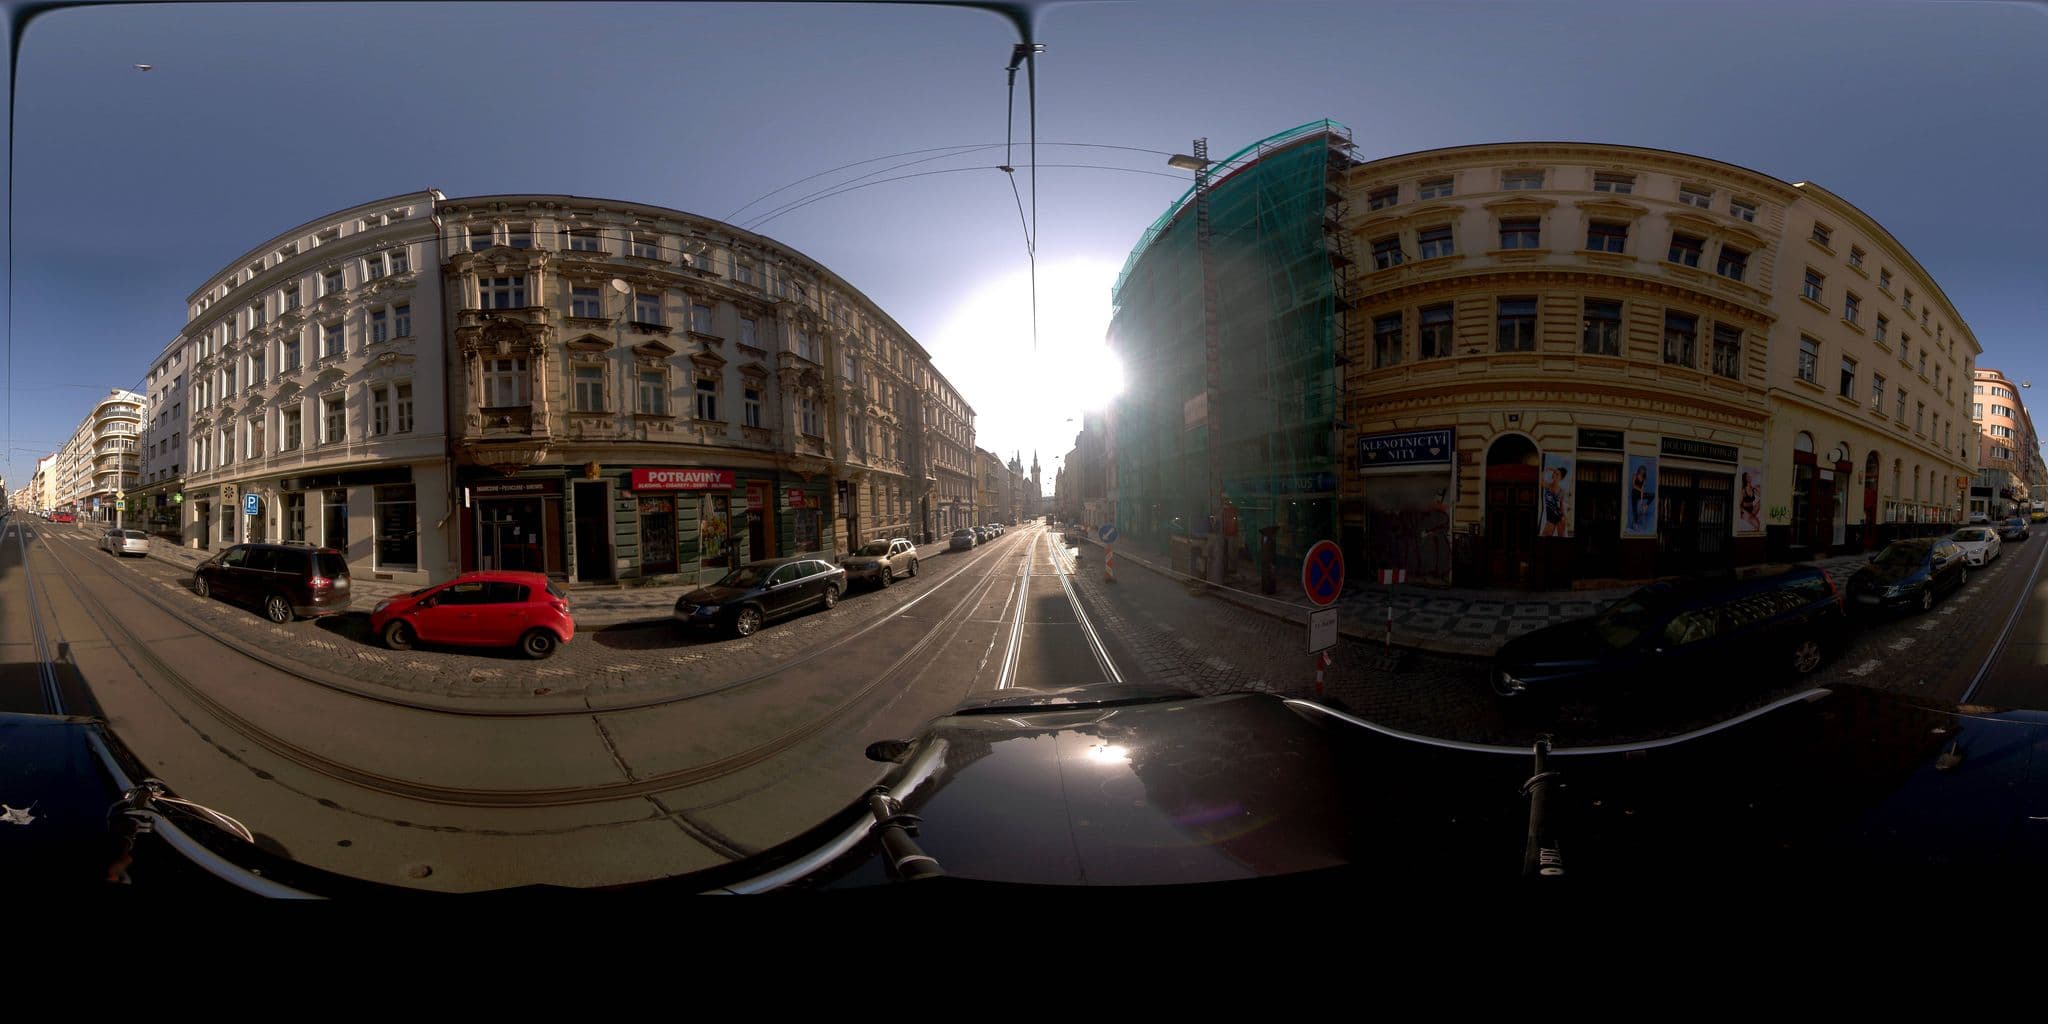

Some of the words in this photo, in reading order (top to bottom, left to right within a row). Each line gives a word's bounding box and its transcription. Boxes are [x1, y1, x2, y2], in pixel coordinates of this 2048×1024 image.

[1362, 431, 1446, 451] KLENOTNICTVÍ
[648, 472, 721, 482] POTRAVINY
[248, 496, 256, 508] P
